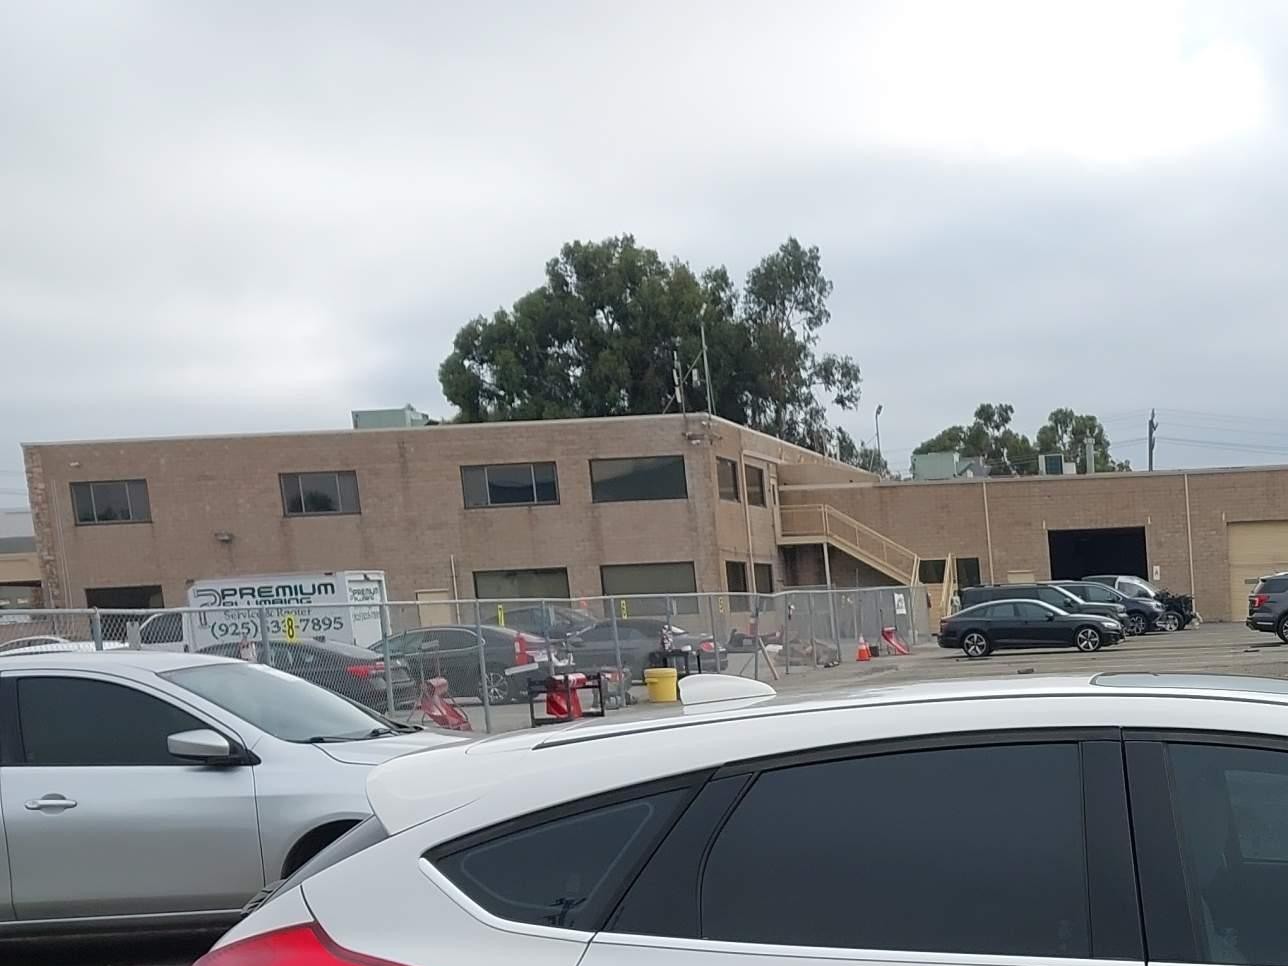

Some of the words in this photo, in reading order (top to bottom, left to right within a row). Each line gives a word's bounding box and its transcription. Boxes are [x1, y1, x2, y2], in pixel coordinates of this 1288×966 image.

[220, 582, 336, 600] PREMIUM
[210, 620, 259, 640] (925)
[286, 616, 295, 639] 8
